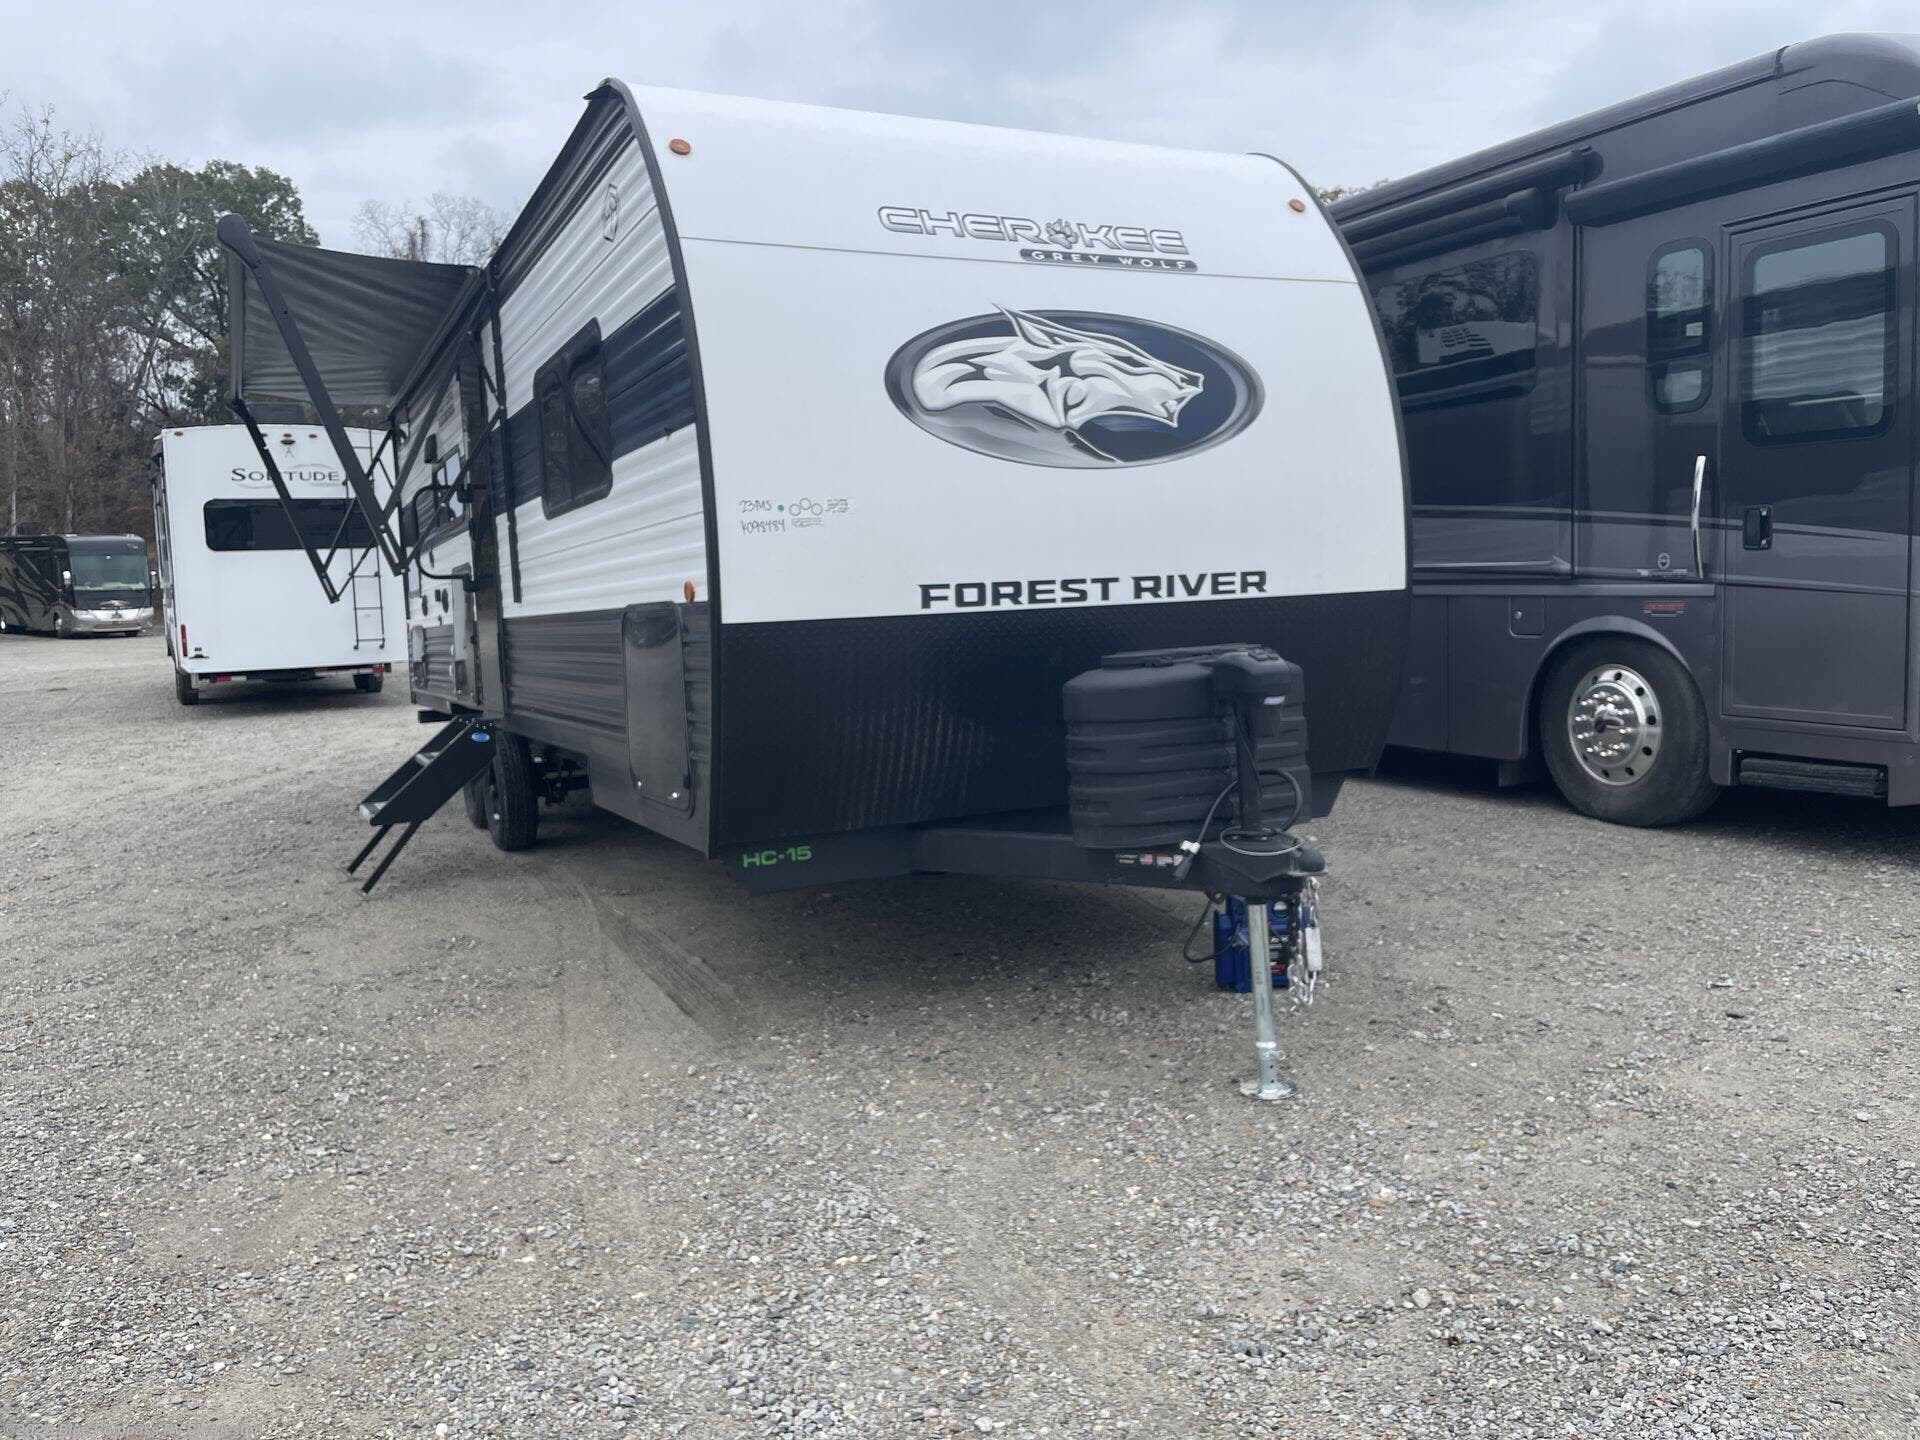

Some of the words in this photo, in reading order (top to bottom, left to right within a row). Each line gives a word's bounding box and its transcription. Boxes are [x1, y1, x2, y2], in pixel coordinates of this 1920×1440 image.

[877, 205, 1190, 255] CHEROKEE
[1031, 251, 1101, 264] GREY
[1118, 257, 1187, 270] WOLF
[231, 467, 340, 482] SOLTUDE
[917, 577, 1120, 609] FOREST
[1131, 571, 1268, 600] RIVER
[742, 845, 813, 869] HC-15
